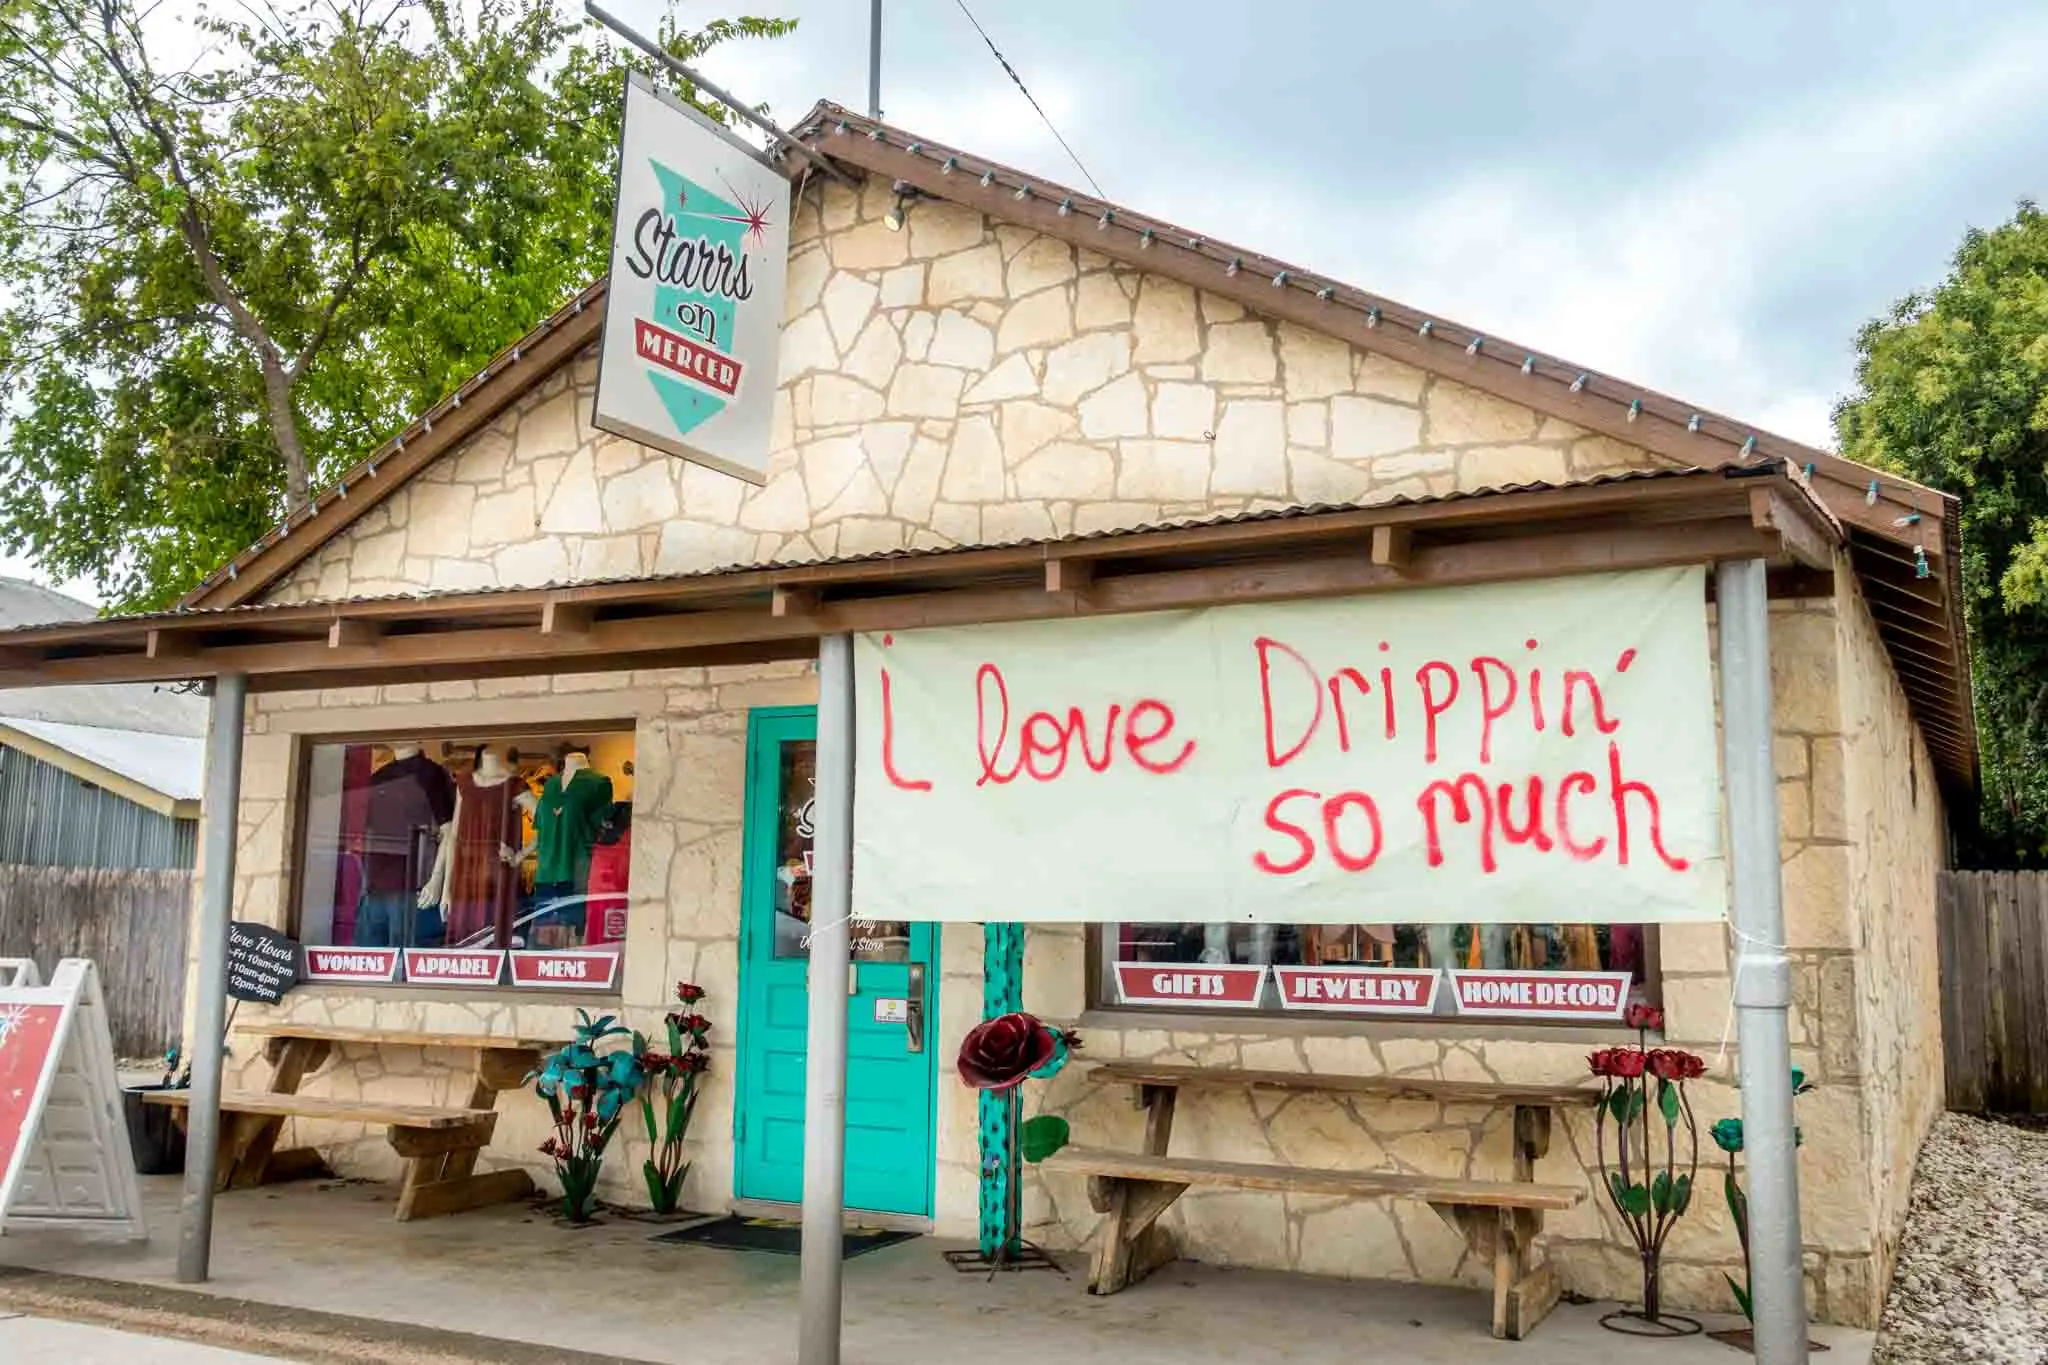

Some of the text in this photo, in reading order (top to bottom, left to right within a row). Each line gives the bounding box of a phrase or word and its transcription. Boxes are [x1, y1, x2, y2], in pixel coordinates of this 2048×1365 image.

[626, 208, 754, 301] Starrs
[677, 302, 717, 345] on
[640, 328, 736, 388] MERCER
[975, 662, 1197, 788] love
[1252, 741, 1691, 875] so much
[255, 936, 293, 961] Hours
[317, 953, 386, 973] WOMENS
[415, 955, 493, 977] APPAREL
[537, 959, 588, 979] MENS
[1152, 973, 1226, 996] GIFTS
[1292, 975, 1421, 1002] JEWELRY
[1463, 980, 1617, 1008] HOME DECOR
